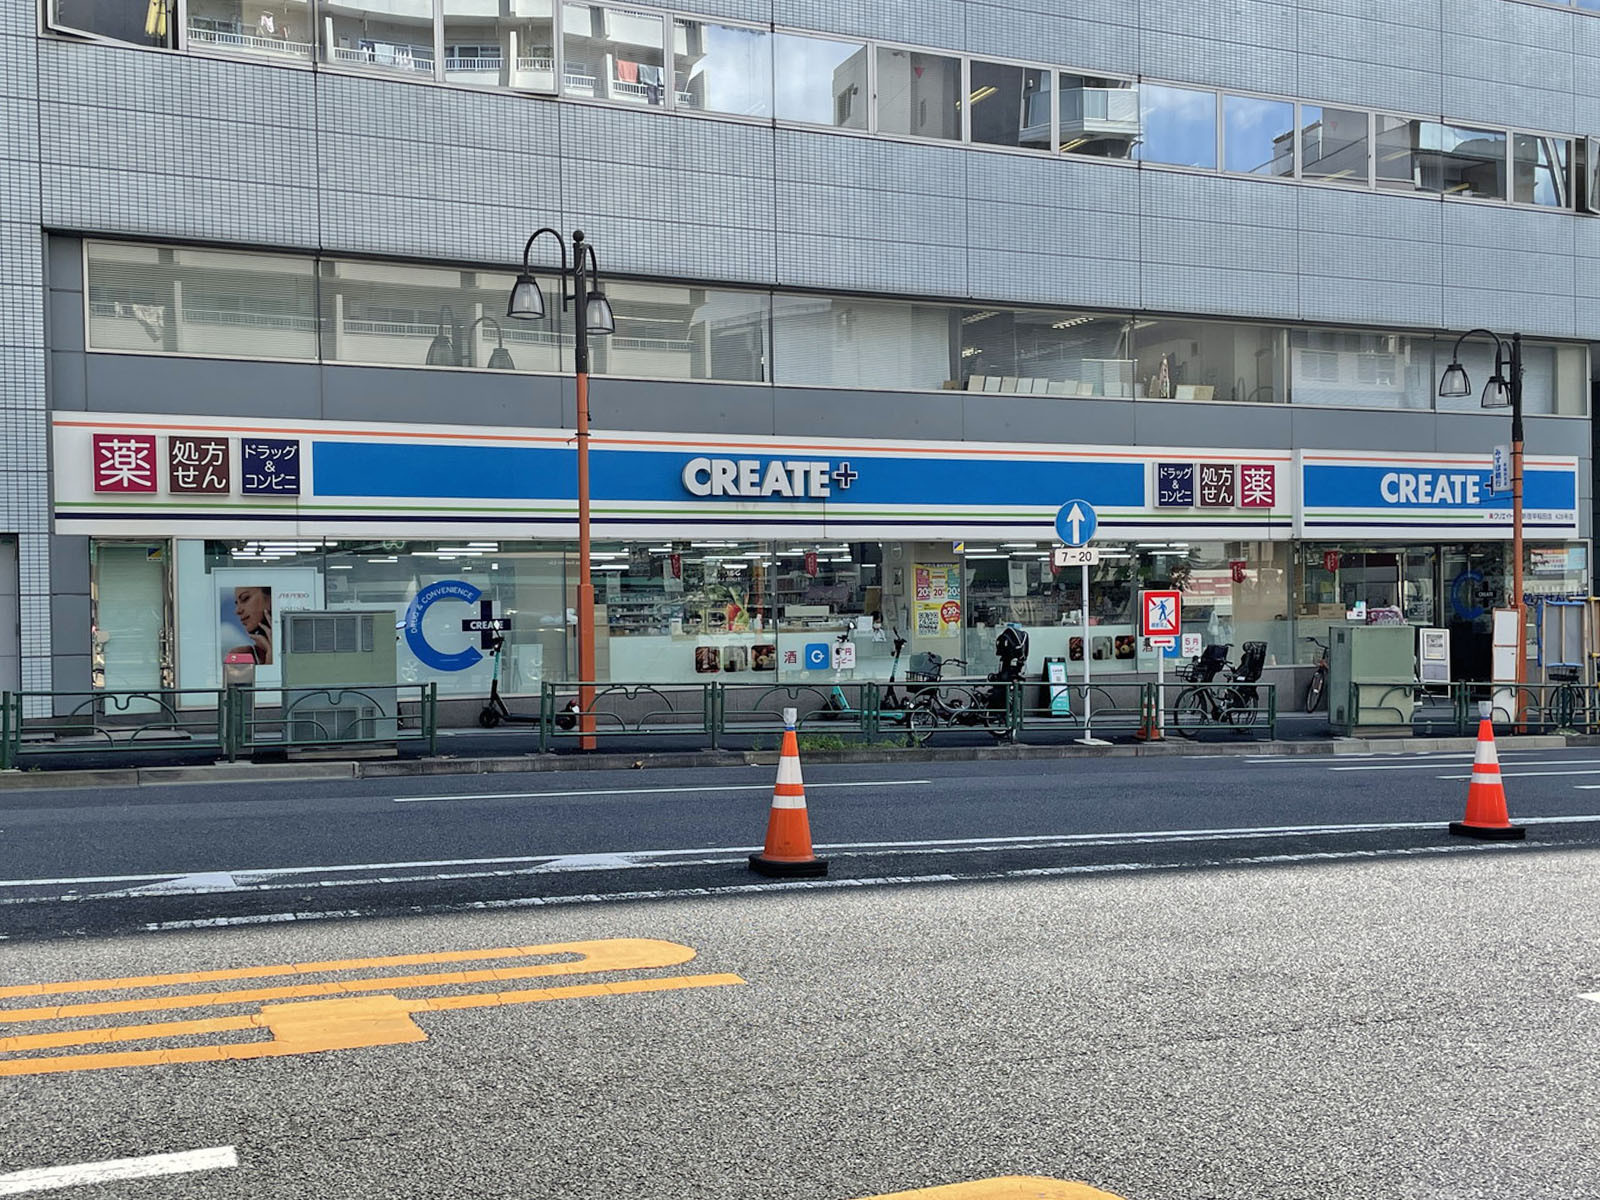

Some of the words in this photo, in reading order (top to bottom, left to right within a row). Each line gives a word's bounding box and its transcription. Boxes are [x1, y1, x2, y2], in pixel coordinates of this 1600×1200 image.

[172, 440, 227, 466] 処方
[244, 444, 298, 460] ドラッグ
[98, 438, 152, 488] 薬
[264, 460, 276, 473] &
[172, 466, 227, 489] せん
[1160, 467, 1193, 479] ドラッグ
[1201, 467, 1233, 486] 処方
[245, 474, 297, 490] コンビニ
[1171, 480, 1179, 489] &
[1243, 468, 1273, 504] 薬
[1160, 490, 1192, 503] コンビニ
[1202, 486, 1233, 503] せん
[421, 586, 474, 604] CONVENIENCE
[469, 621, 504, 630] CREAE
[784, 650, 798, 665] 酒
